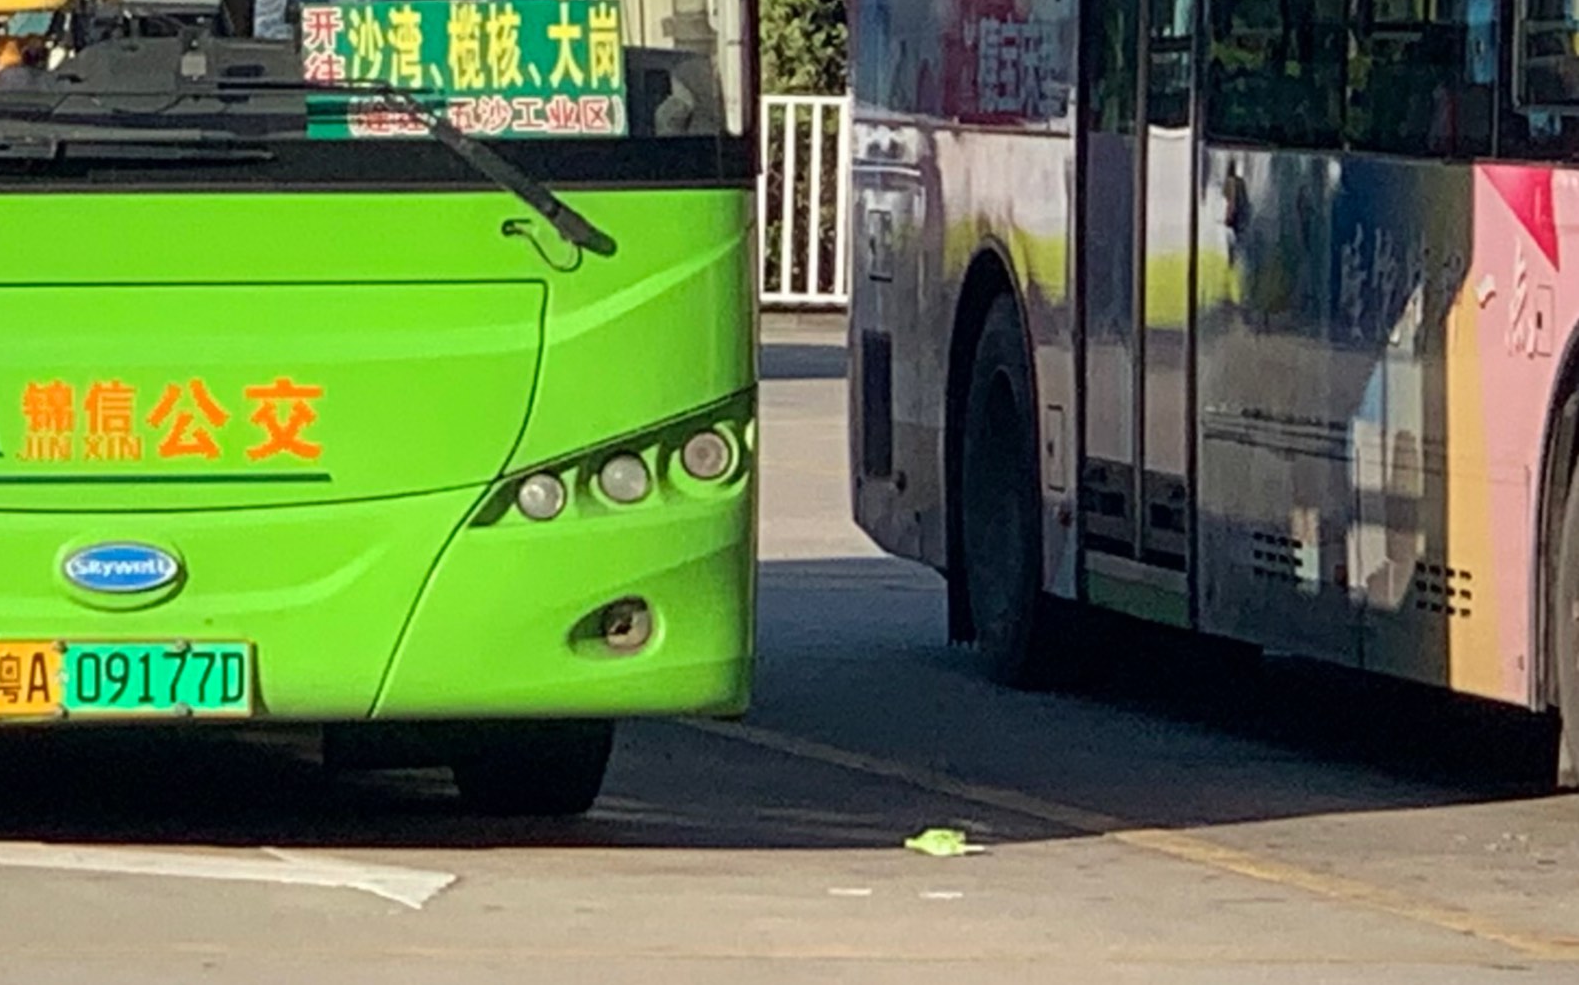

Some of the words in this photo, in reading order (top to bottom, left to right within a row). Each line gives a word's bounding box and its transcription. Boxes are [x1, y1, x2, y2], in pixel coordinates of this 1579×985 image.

[302, 6, 346, 86] 开往
[15, 435, 73, 462] JIN
[83, 435, 143, 462] XIN
